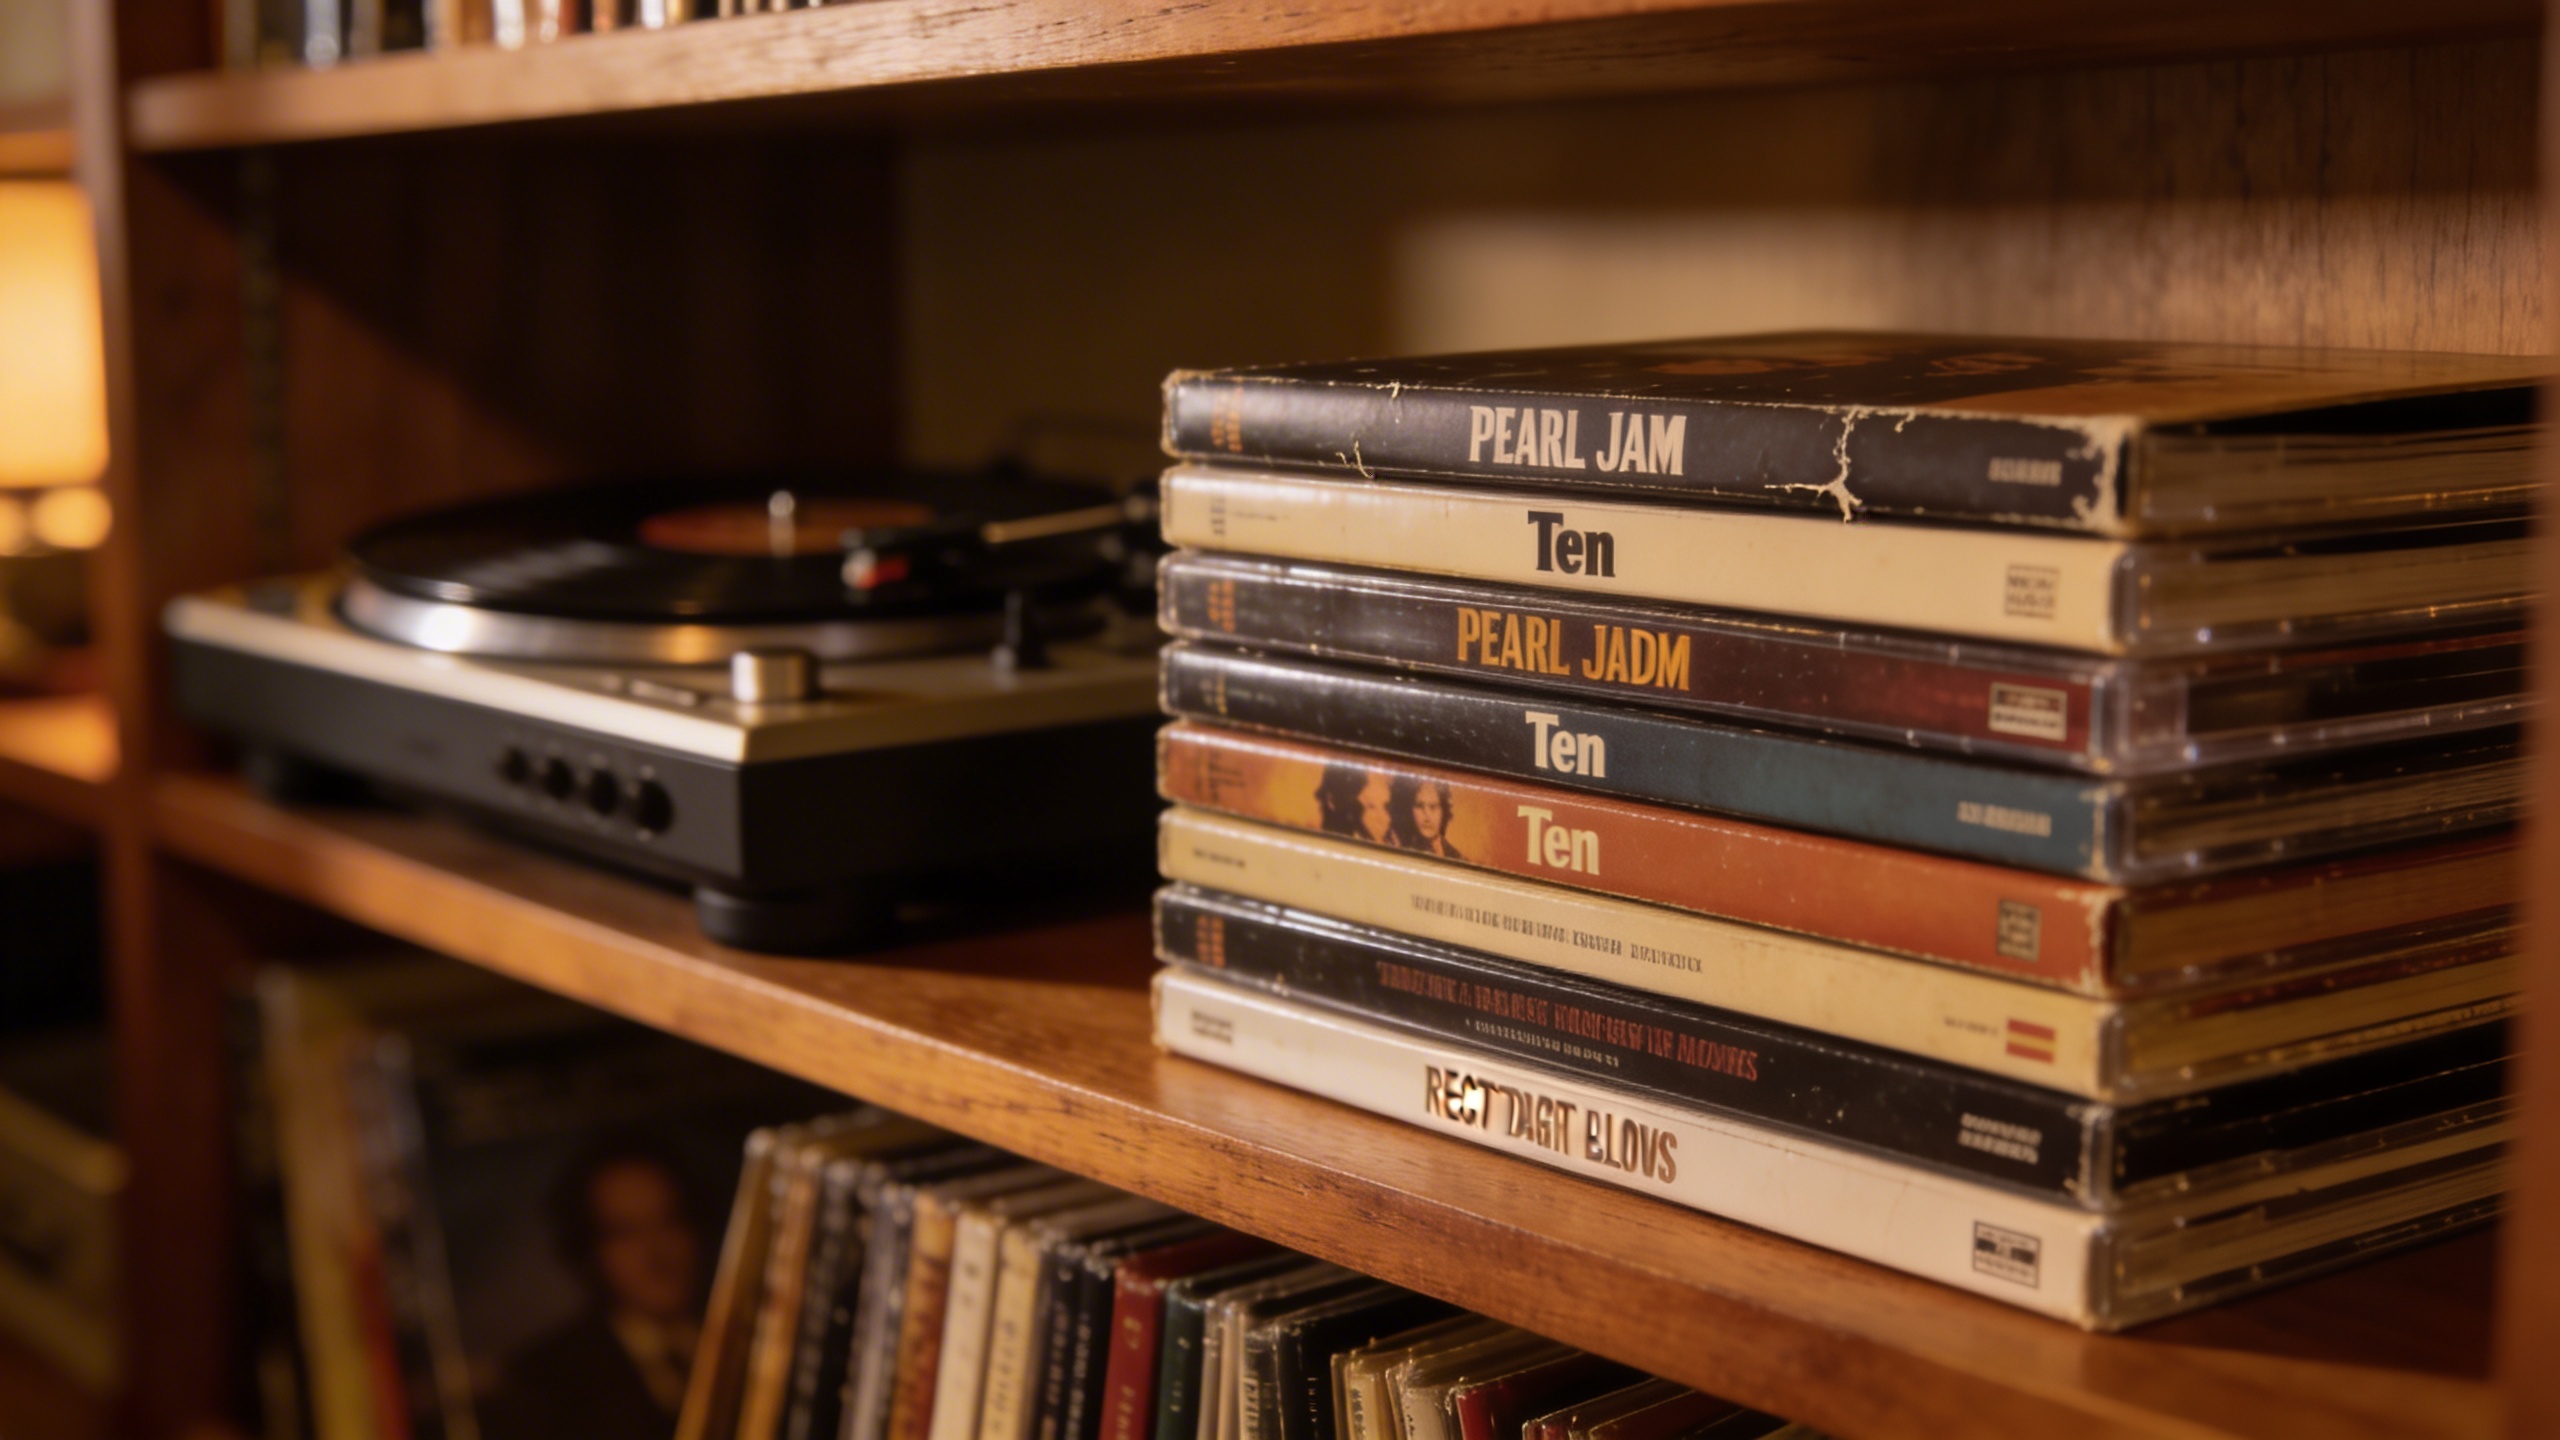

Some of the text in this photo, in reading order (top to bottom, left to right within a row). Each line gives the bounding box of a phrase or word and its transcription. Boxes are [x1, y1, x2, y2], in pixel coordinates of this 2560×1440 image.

[1469, 405, 1687, 477] PEARL JAM
[1528, 510, 1616, 578] Ten
[1457, 608, 1691, 691] PEARL JADM
[1526, 711, 1606, 778] Ten
[1517, 806, 1600, 876] Ten
